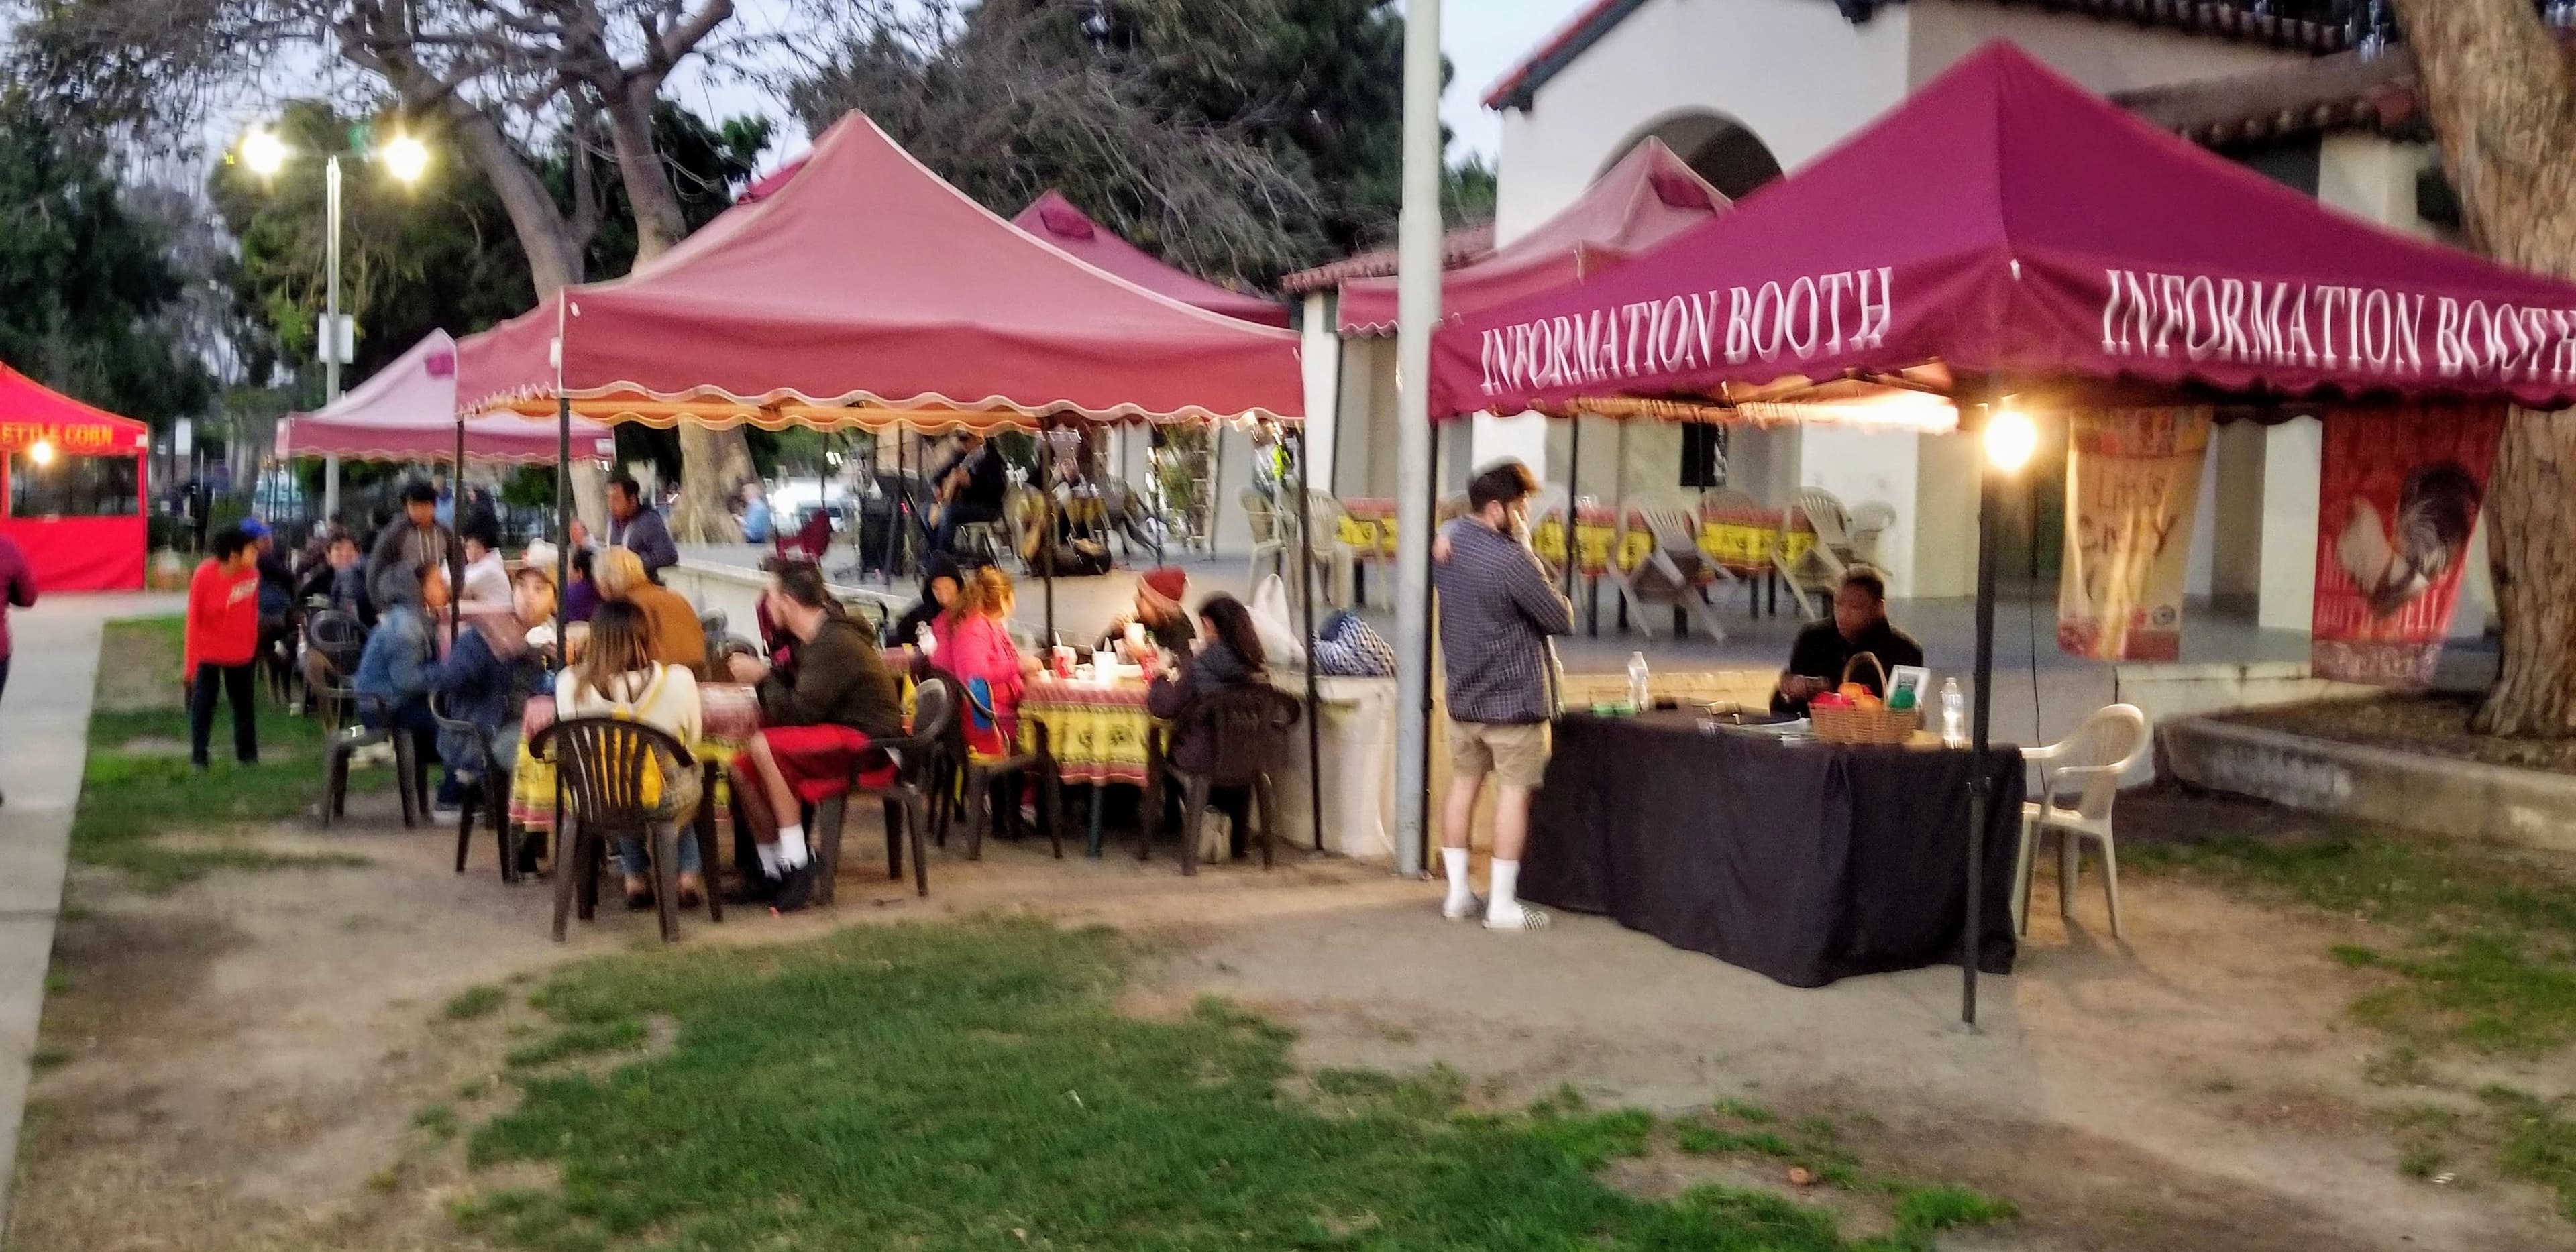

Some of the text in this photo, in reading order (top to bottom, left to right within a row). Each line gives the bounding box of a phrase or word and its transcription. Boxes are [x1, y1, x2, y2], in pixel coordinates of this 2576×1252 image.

[1480, 267, 1892, 396] INFORMATION BOOTH
[2101, 268, 2576, 380] INFORMATION BOOTH
[65, 424, 113, 445] CORN
